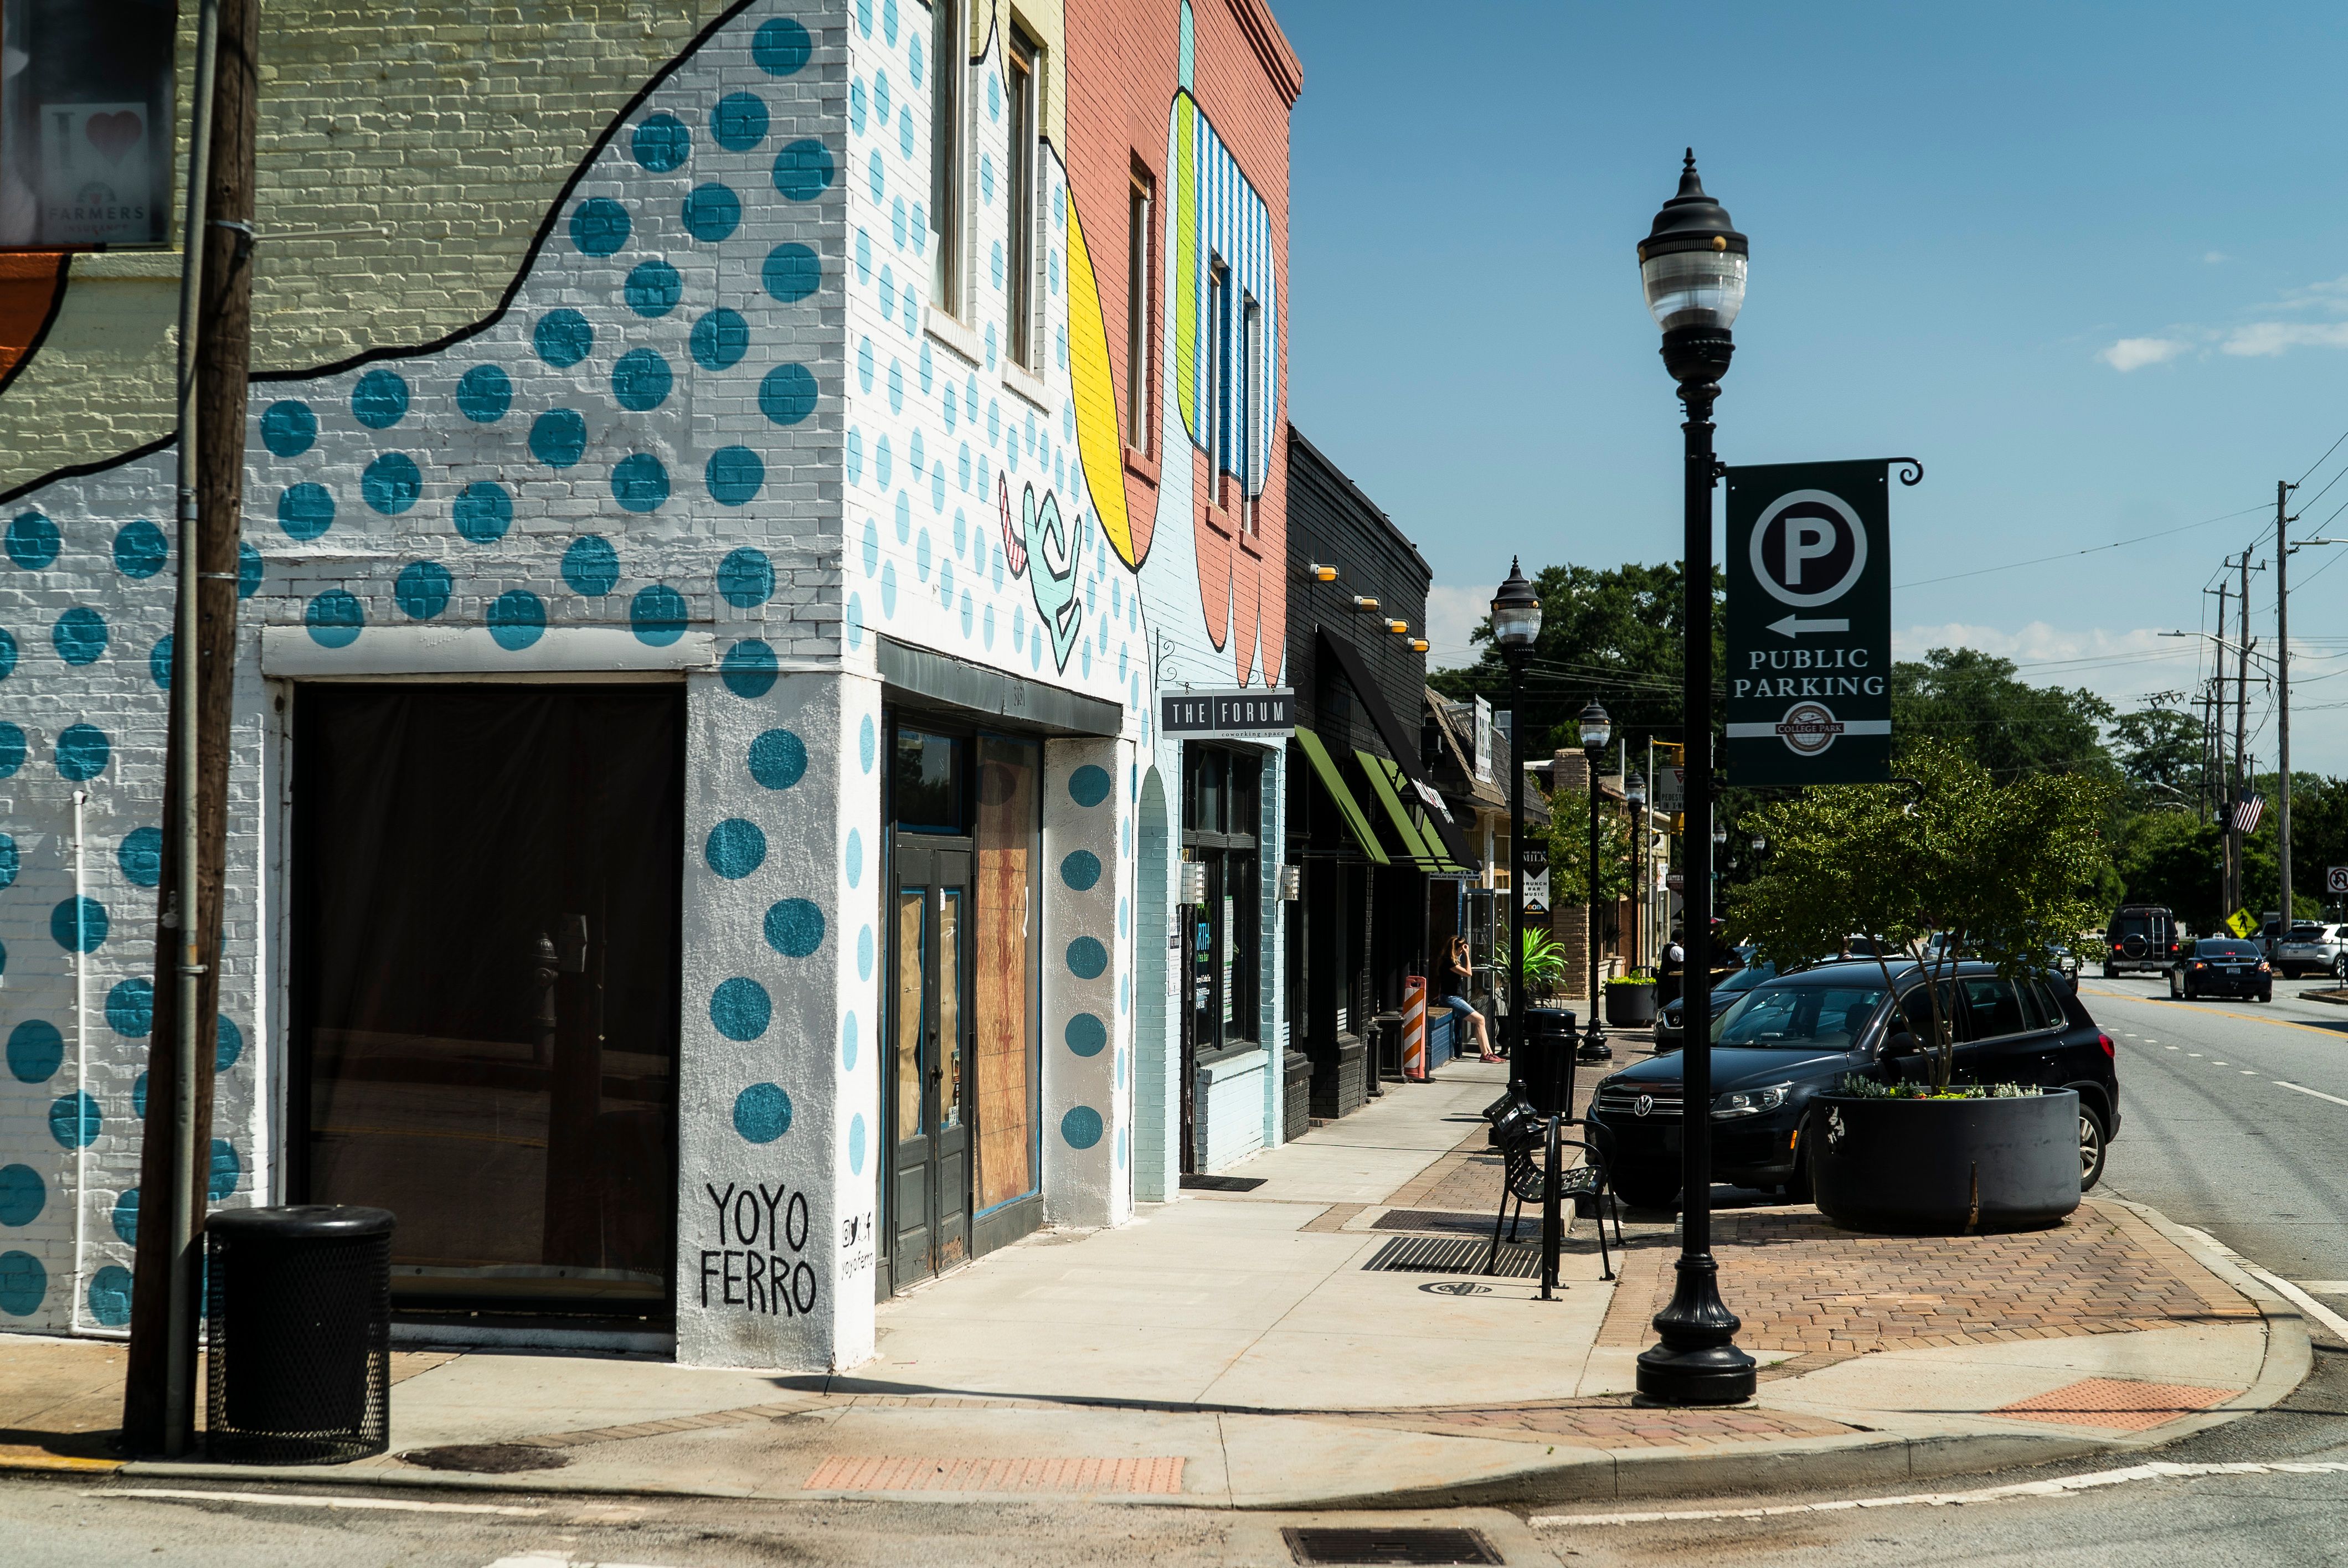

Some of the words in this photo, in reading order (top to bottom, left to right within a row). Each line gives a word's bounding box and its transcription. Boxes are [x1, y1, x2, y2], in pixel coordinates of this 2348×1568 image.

[48, 206, 144, 220] FARMERS
[65, 223, 128, 233] INSURANCE
[1785, 517, 1836, 585] P
[1749, 649, 1868, 669] PUBLIC
[1734, 676, 1885, 698] PARKING
[1173, 704, 1205, 723] THE
[1222, 702, 1283, 722] FORUM
[1778, 725, 1816, 733] COLLEGE
[706, 1182, 809, 1252] YOYO
[842, 1250, 873, 1281] yoyoferro
[701, 1250, 816, 1317] FERRO
